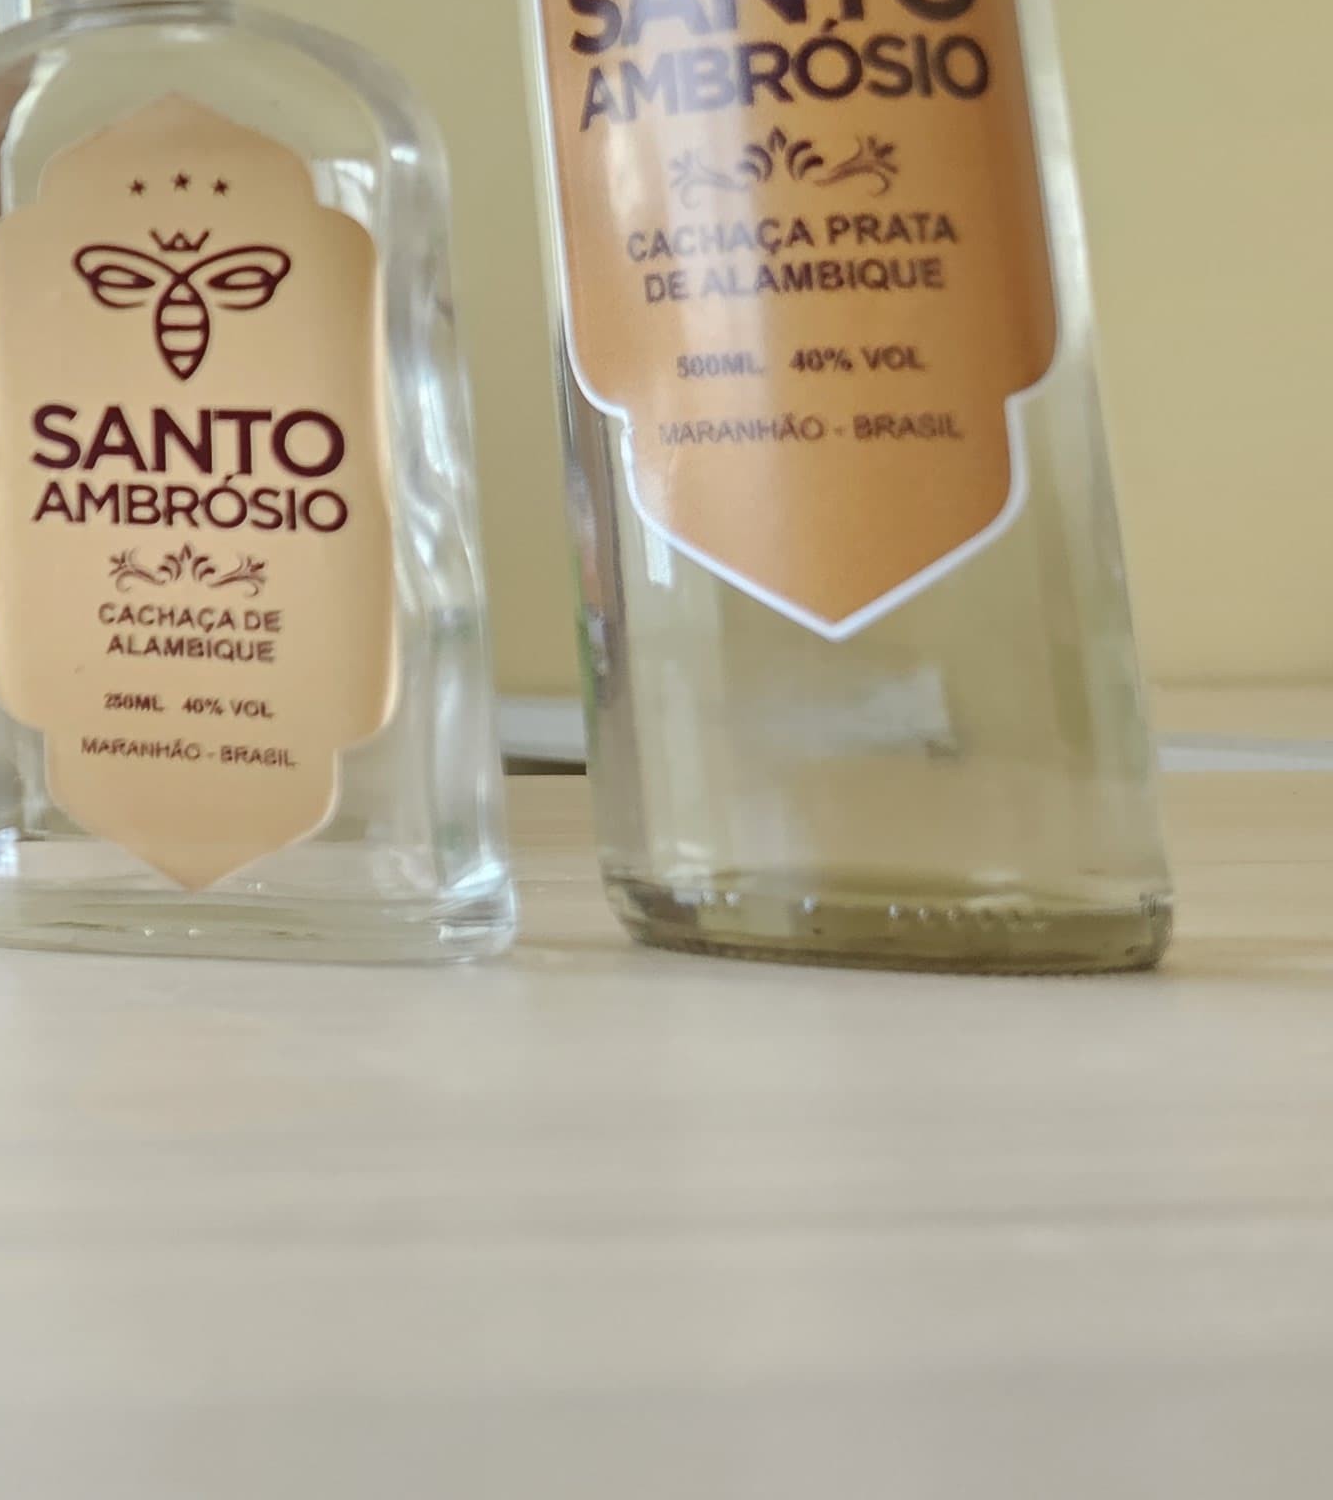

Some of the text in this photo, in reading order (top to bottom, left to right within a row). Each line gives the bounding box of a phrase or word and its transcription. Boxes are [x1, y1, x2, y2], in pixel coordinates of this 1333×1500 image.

[579, 18, 989, 132] AMBRÓSIO
[627, 212, 957, 262] CACHAÇA PRATA
[643, 257, 945, 303] DE ALAMBIQUE
[676, 345, 925, 378] 500ML 40% VOL
[32, 403, 345, 478] SANTO
[659, 413, 824, 445] MARANHÃO
[852, 412, 965, 440] BRASIL
[32, 472, 348, 533] AMBRÓSIO
[98, 603, 282, 633] CACHAÇA DE
[106, 634, 275, 662] ALAMBIQUE
[104, 693, 275, 718] 250ML 40% VOL
[81, 736, 201, 760] MARANHÃO
[220, 745, 297, 767] BRASIL
